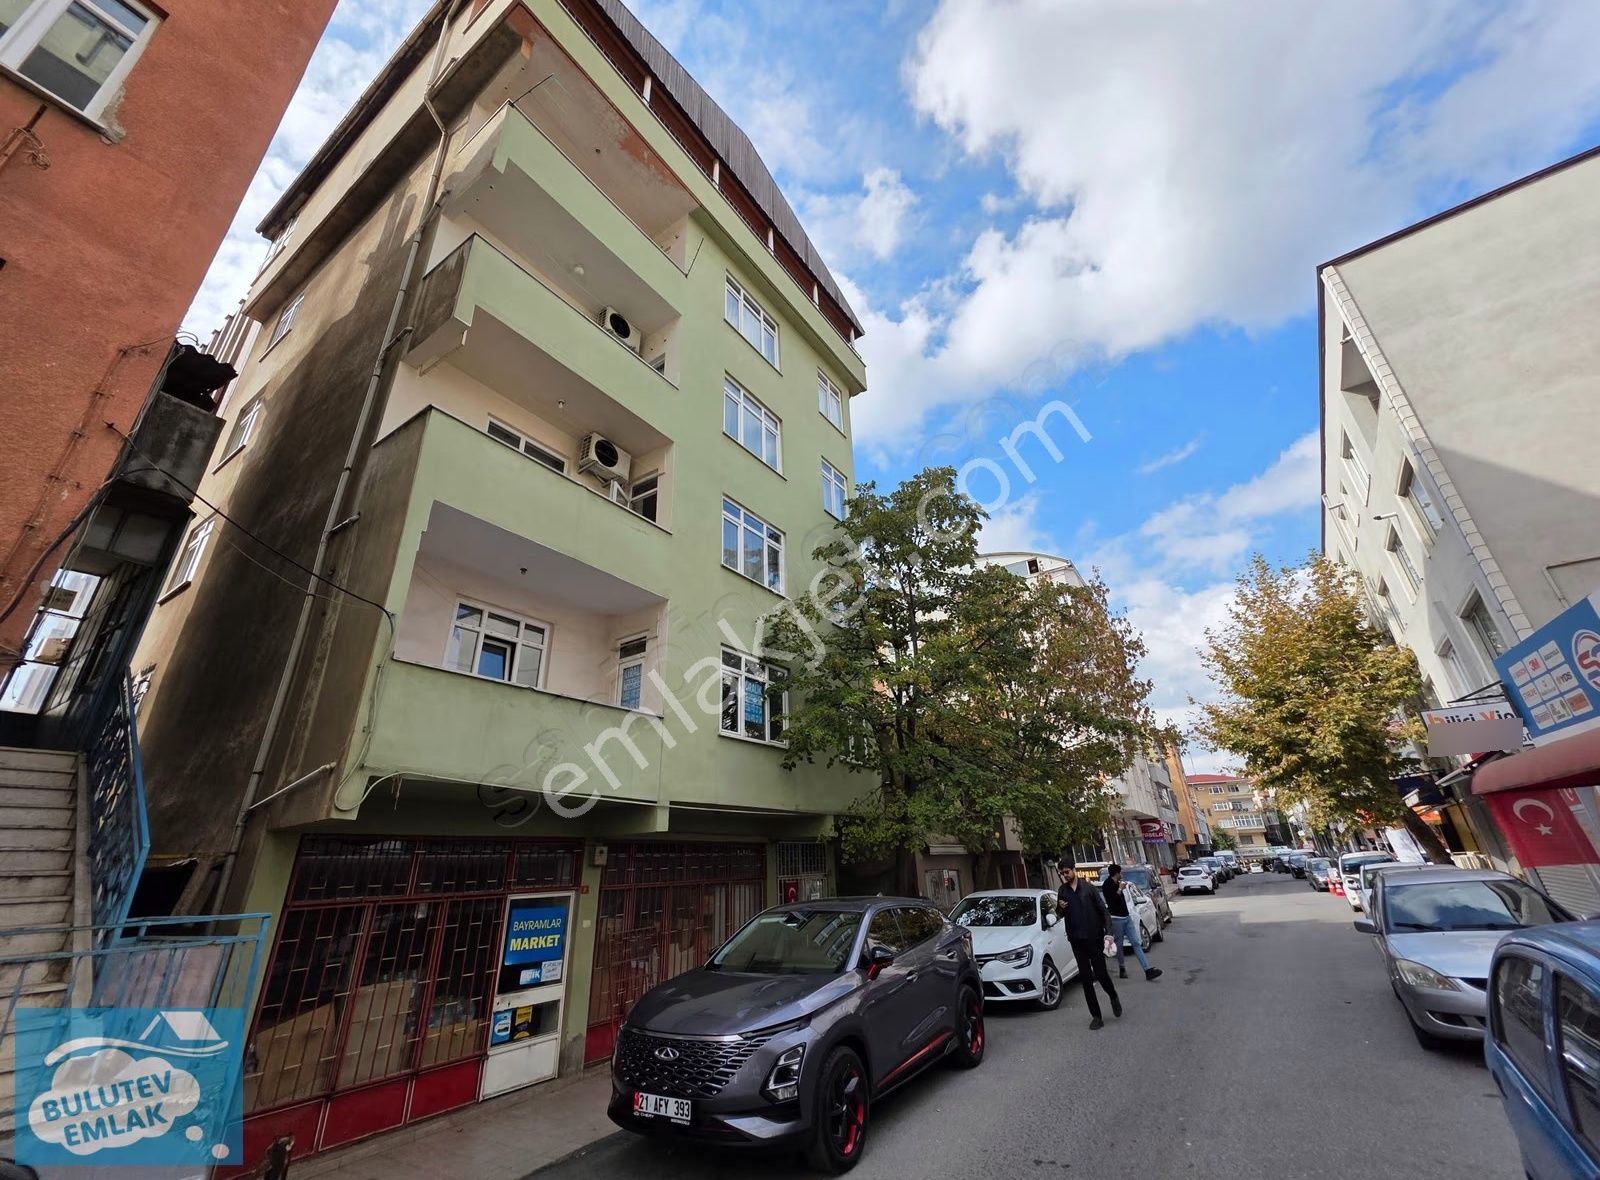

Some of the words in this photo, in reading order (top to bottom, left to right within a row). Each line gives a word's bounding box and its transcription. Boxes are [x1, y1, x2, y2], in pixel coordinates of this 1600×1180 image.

[513, 918, 562, 931] BAYRAMLAR
[510, 934, 560, 951] MARKET
[639, 1094, 649, 1111] 21
[653, 1097, 669, 1114] AFY
[674, 1100, 690, 1118] 393
